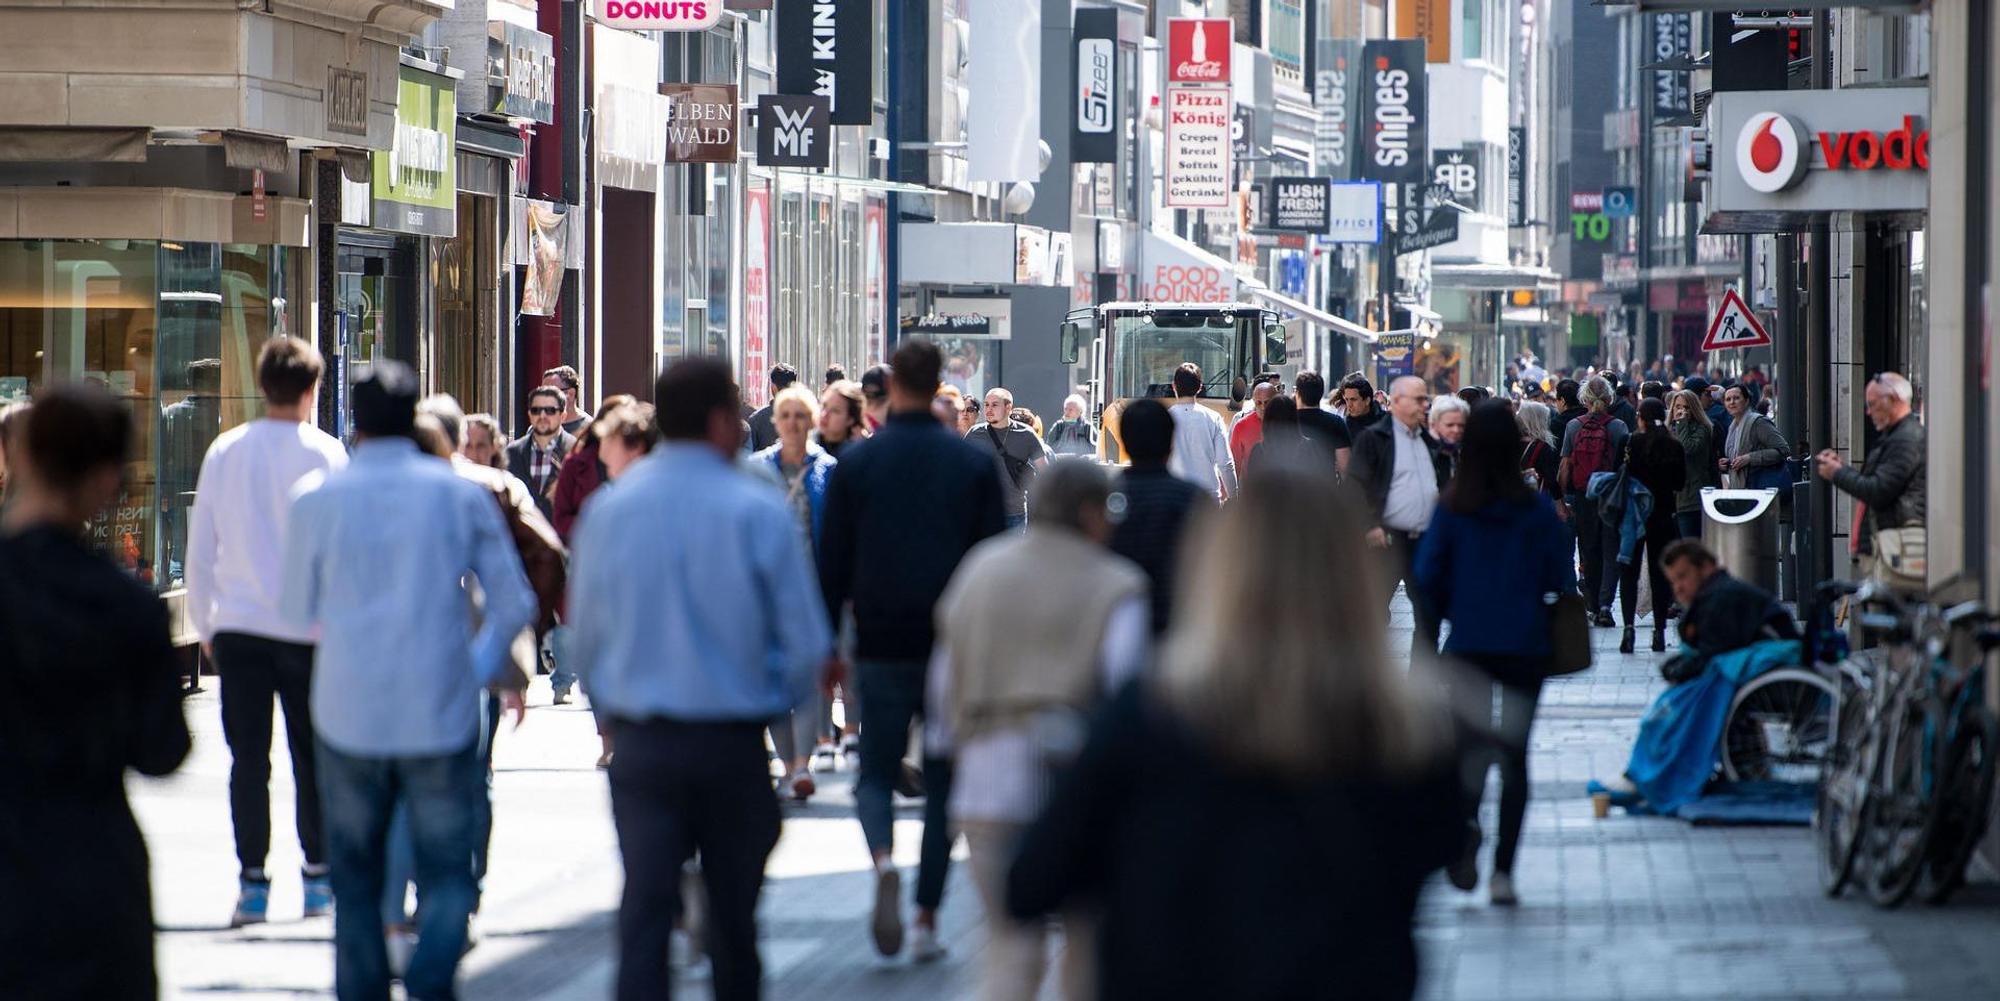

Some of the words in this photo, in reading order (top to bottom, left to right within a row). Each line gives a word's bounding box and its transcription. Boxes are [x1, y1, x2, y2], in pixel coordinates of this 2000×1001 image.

[606, 1, 707, 20] DONUTS
[813, 0, 836, 59] KIN
[1656, 13, 1674, 109] MAIONS
[1176, 93, 1223, 106] Pizza
[1172, 112, 1226, 128] König
[1375, 70, 1416, 167] snipes
[667, 127, 731, 145] WALD
[773, 105, 815, 157] WMF
[1179, 133, 1218, 143] Crepes
[1181, 147, 1216, 155] Brezel
[1178, 160, 1218, 169] Softeis
[1279, 184, 1325, 198] LUSH
[1278, 198, 1325, 211] FRESH
[1278, 218, 1324, 227] COSMETICS
[1571, 213, 1610, 240] TO
[1156, 265, 1220, 286] FOOD
[1145, 283, 1230, 302] LOUNGE
